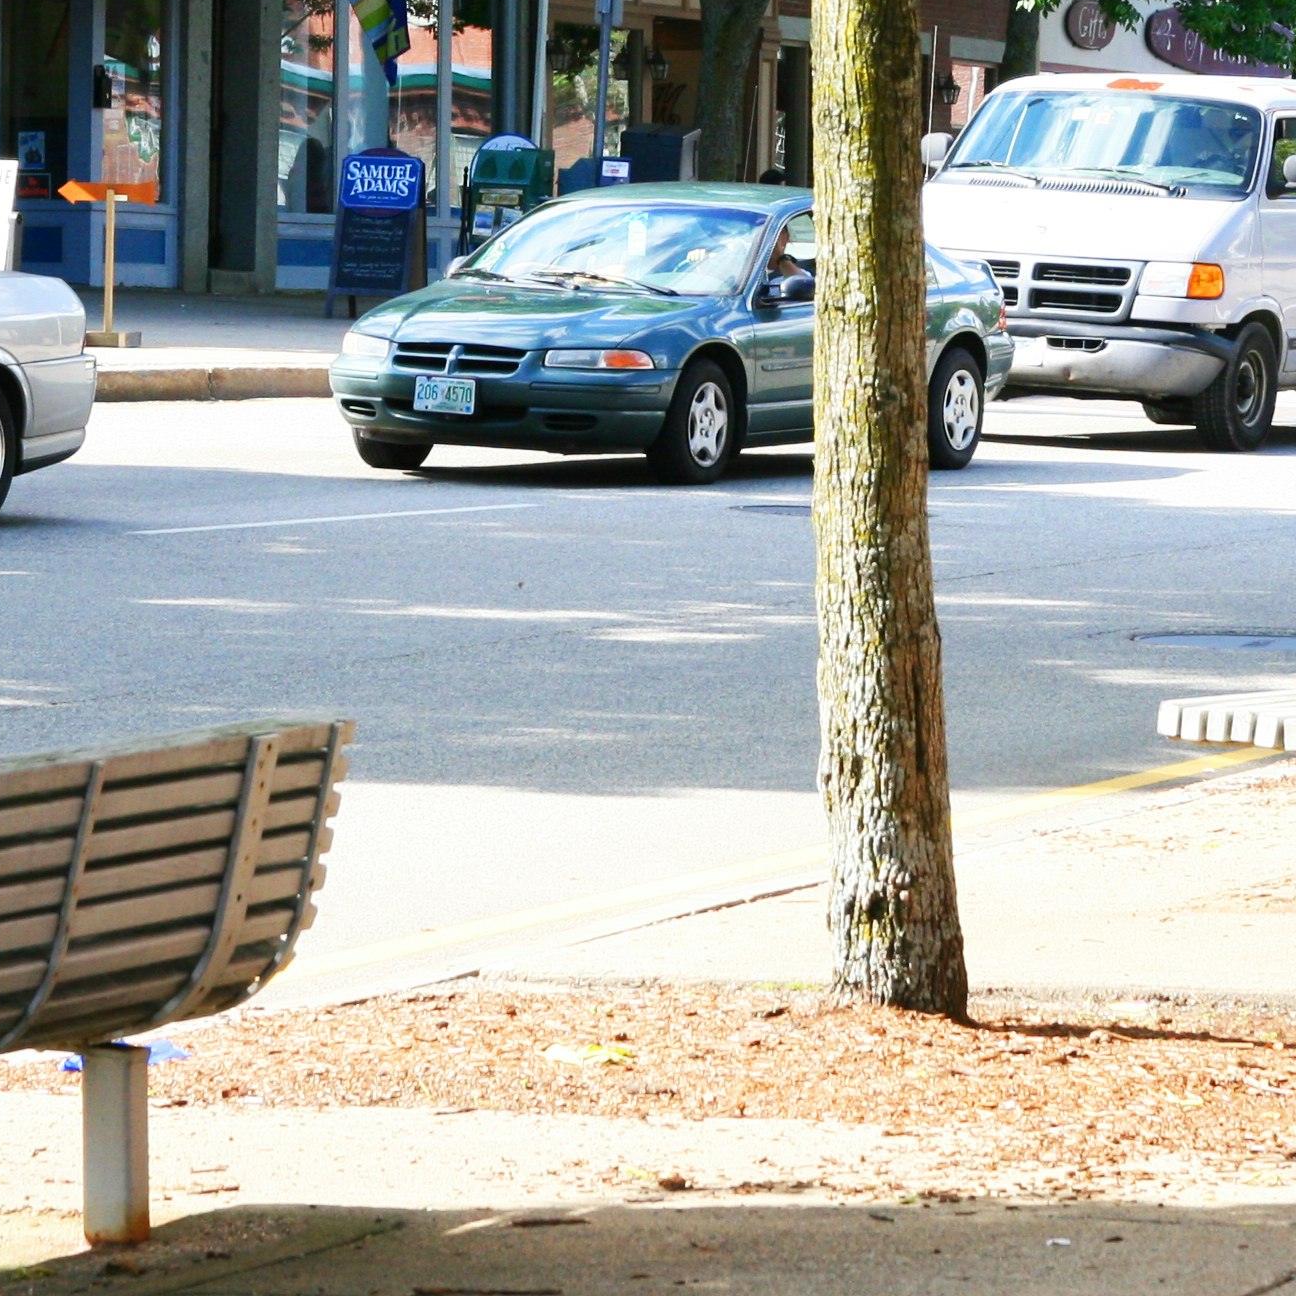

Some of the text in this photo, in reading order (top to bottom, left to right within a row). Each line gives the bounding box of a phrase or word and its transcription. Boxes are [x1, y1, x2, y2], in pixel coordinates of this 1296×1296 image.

[347, 161, 416, 182] SAMUEL
[350, 178, 409, 197] ADAMS
[417, 383, 472, 403] 206 4570
